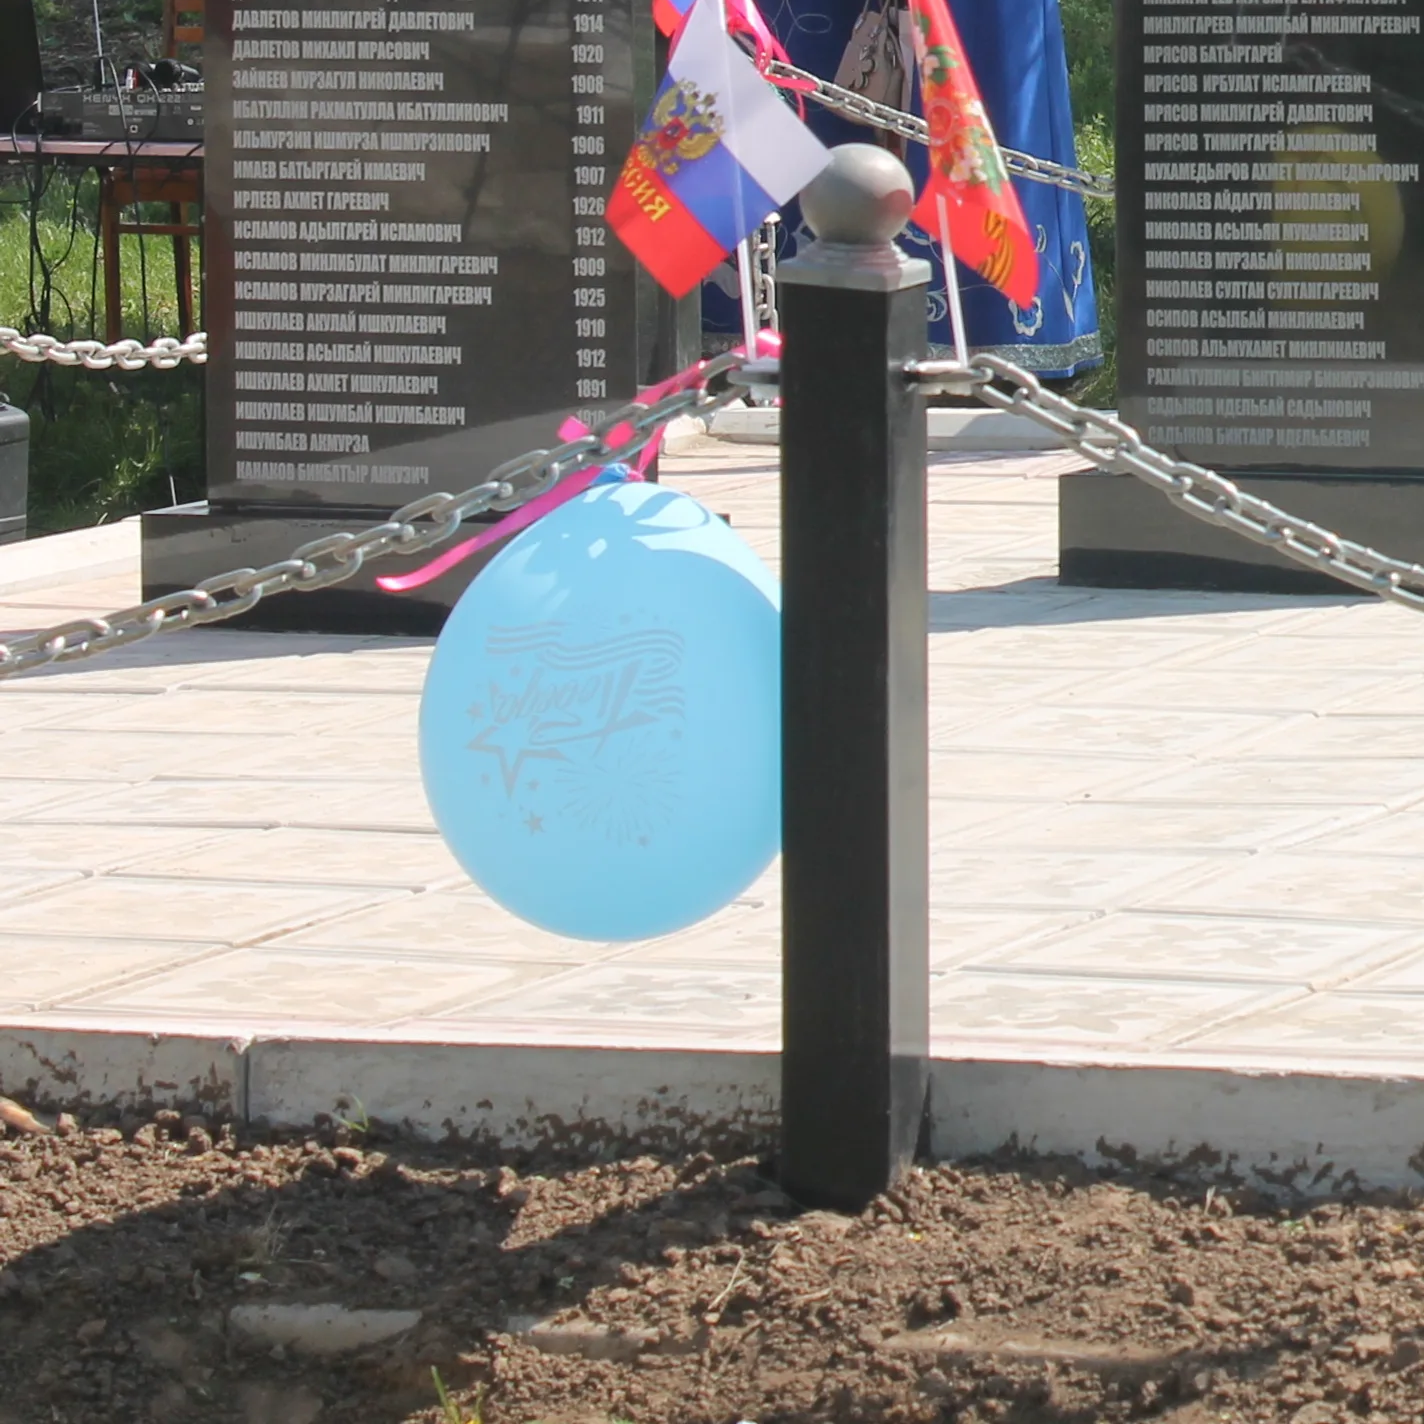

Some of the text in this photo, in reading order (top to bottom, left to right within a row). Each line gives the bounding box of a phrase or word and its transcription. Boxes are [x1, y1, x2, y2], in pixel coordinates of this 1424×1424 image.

[572, 44, 603, 63] 1920
[575, 166, 605, 184] 1907
[574, 287, 605, 307] 1925
[577, 379, 606, 397] 1891
